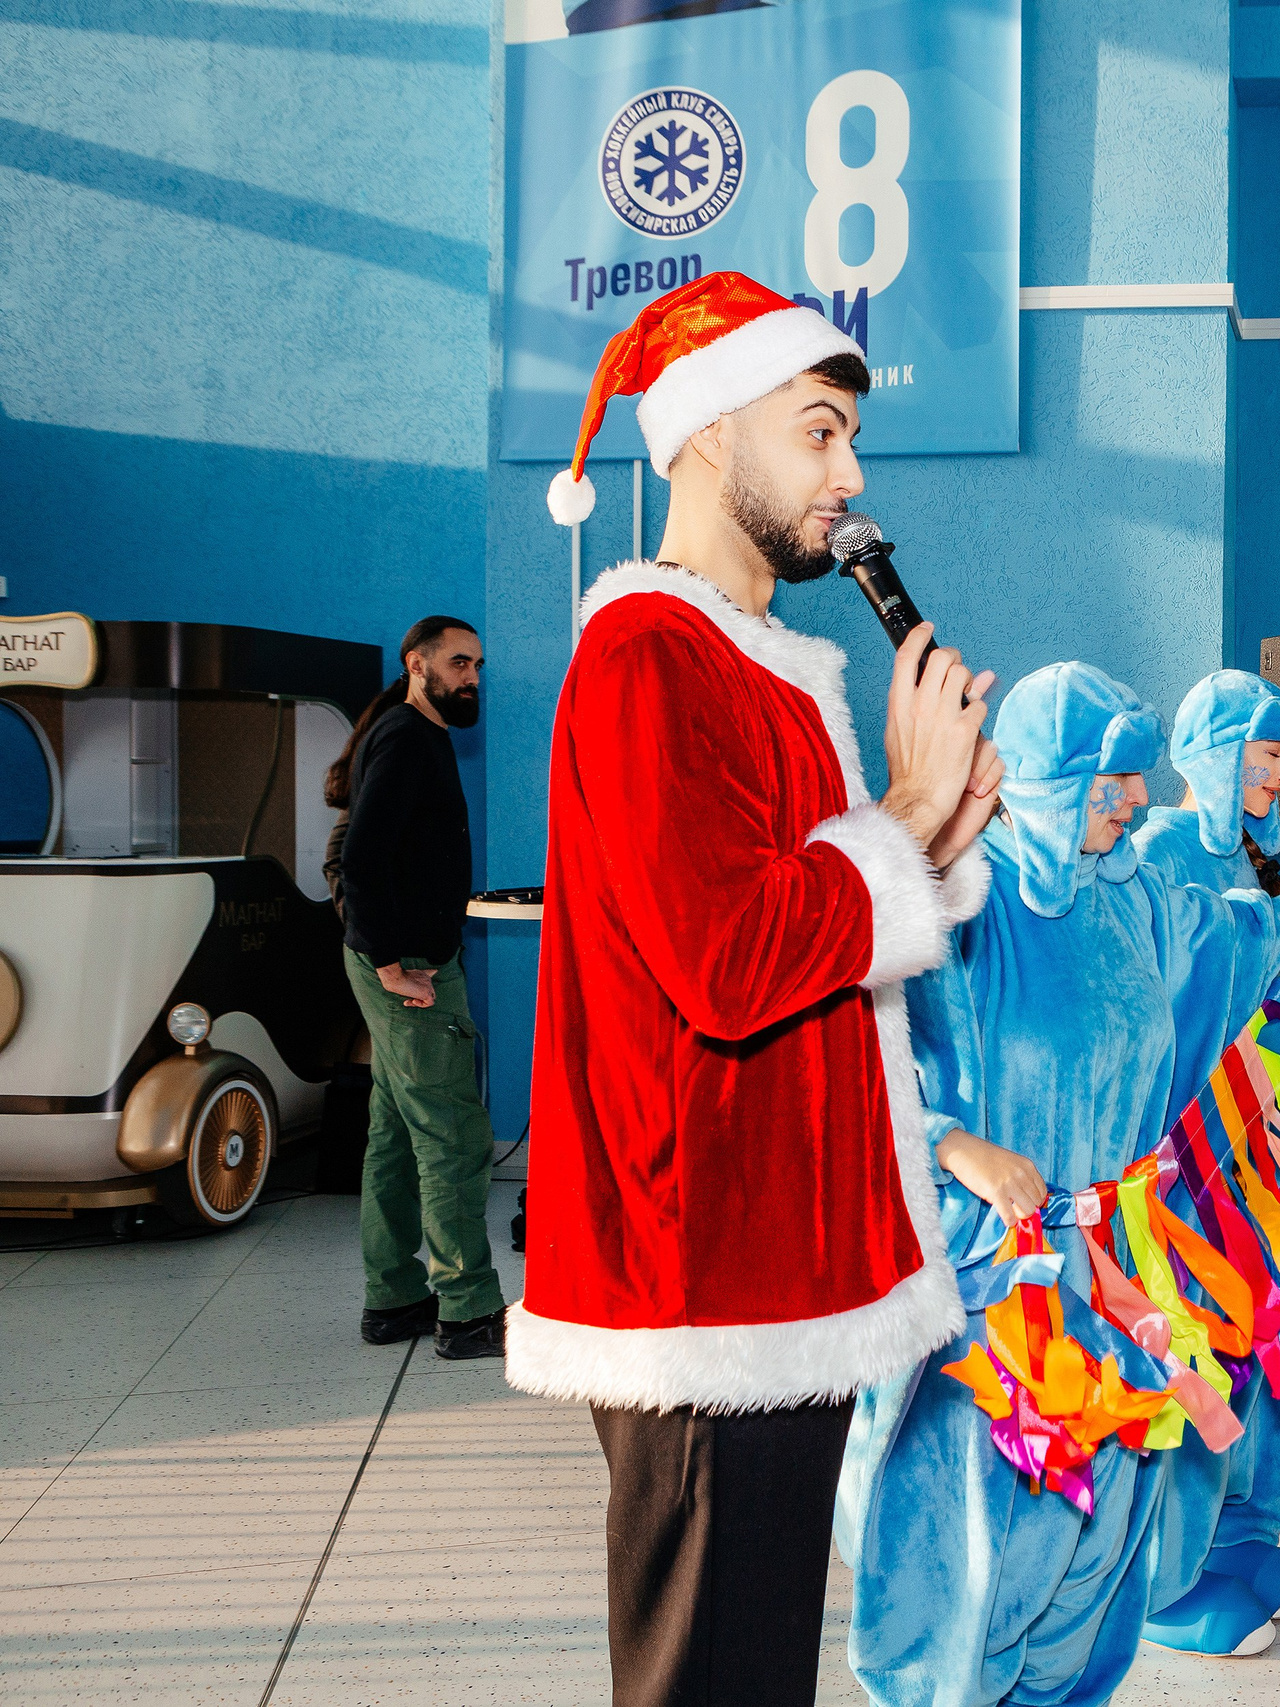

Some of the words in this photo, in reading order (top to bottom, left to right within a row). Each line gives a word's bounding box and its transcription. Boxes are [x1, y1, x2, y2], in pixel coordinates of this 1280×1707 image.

[605, 91, 668, 160] ХОККЕЙНЫЙ
[670, 92, 707, 112] КЛУБ
[704, 105, 739, 155] СИБИРЬ
[605, 171, 698, 234] НОВОСИБИРСКАЯ
[698, 168, 739, 223] ОБЛАСТЬ
[804, 69, 910, 302] 8
[3, 657, 38, 672] БАР
